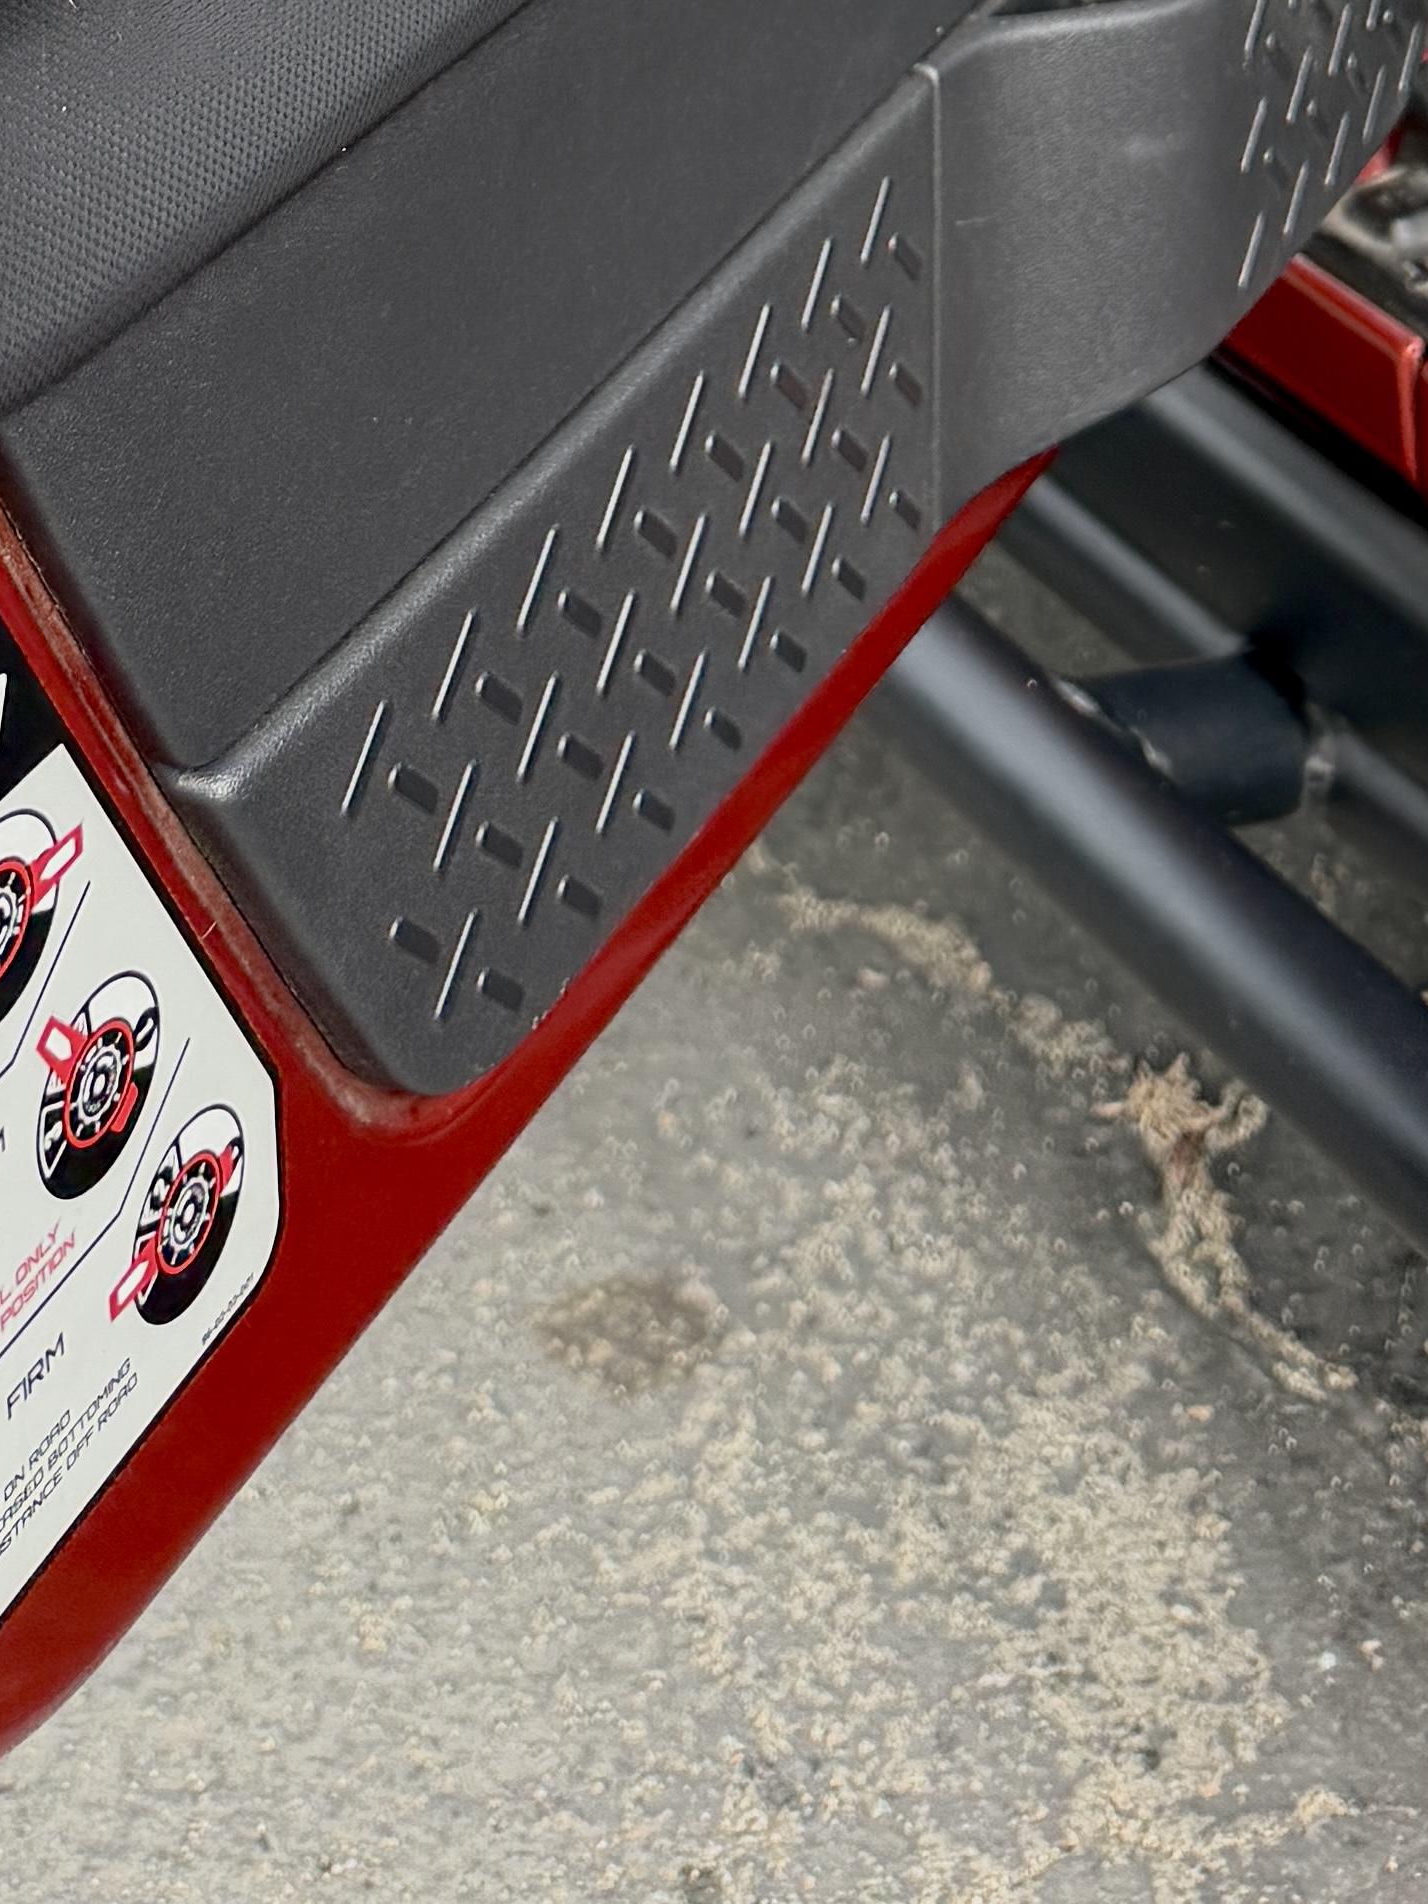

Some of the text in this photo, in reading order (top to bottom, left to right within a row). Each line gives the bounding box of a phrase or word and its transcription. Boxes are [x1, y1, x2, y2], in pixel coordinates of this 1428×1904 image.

[0, 1228, 76, 1333] POSITION
[14, 1217, 61, 1286] ONLY
[6, 1331, 66, 1421] FIRM
[47, 1357, 132, 1471] BOTTOMING
[66, 1423, 95, 1471] OFF
[97, 1371, 139, 1432] ROAD
[4, 1465, 26, 1502] ON
[28, 1409, 71, 1470] ROAD
